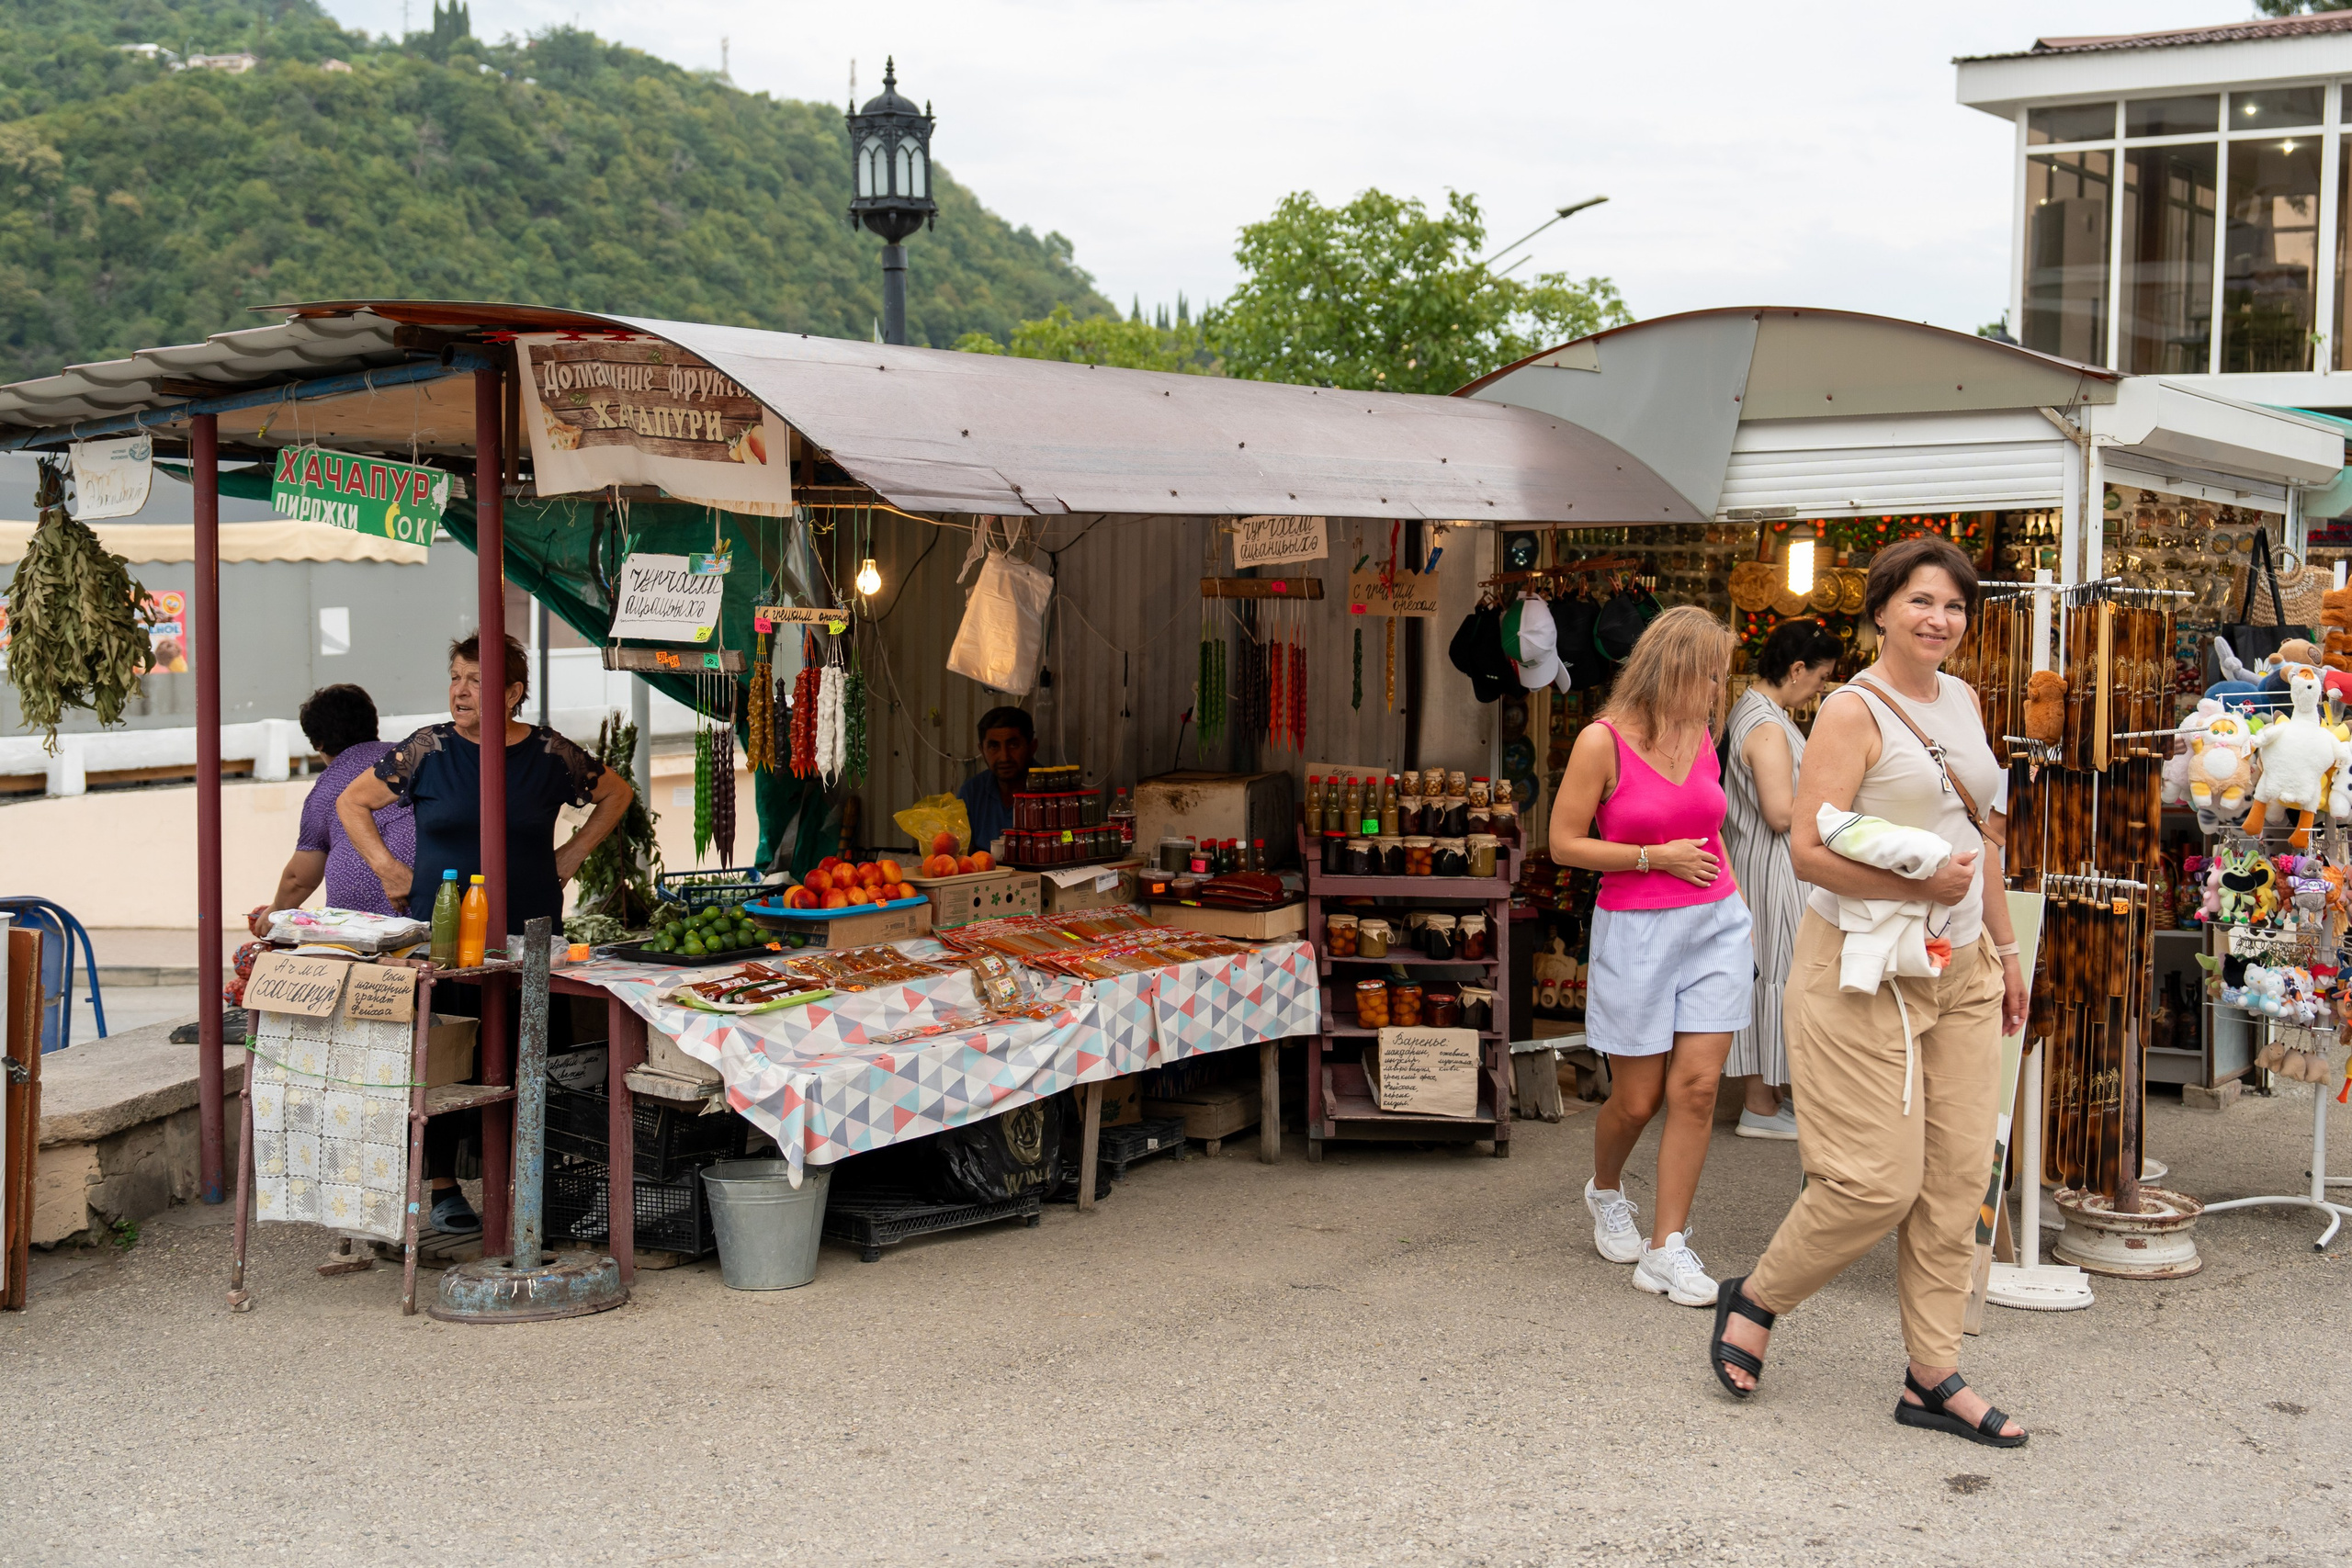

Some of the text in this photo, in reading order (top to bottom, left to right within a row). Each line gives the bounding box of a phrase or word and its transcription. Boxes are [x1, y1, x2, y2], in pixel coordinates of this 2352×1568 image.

[543, 359, 655, 399] Домашние
[590, 399, 725, 442] ХАЧАПУРИ
[277, 448, 431, 507] ХАЧАПУР
[275, 491, 359, 530] ПИРОЖКИ
